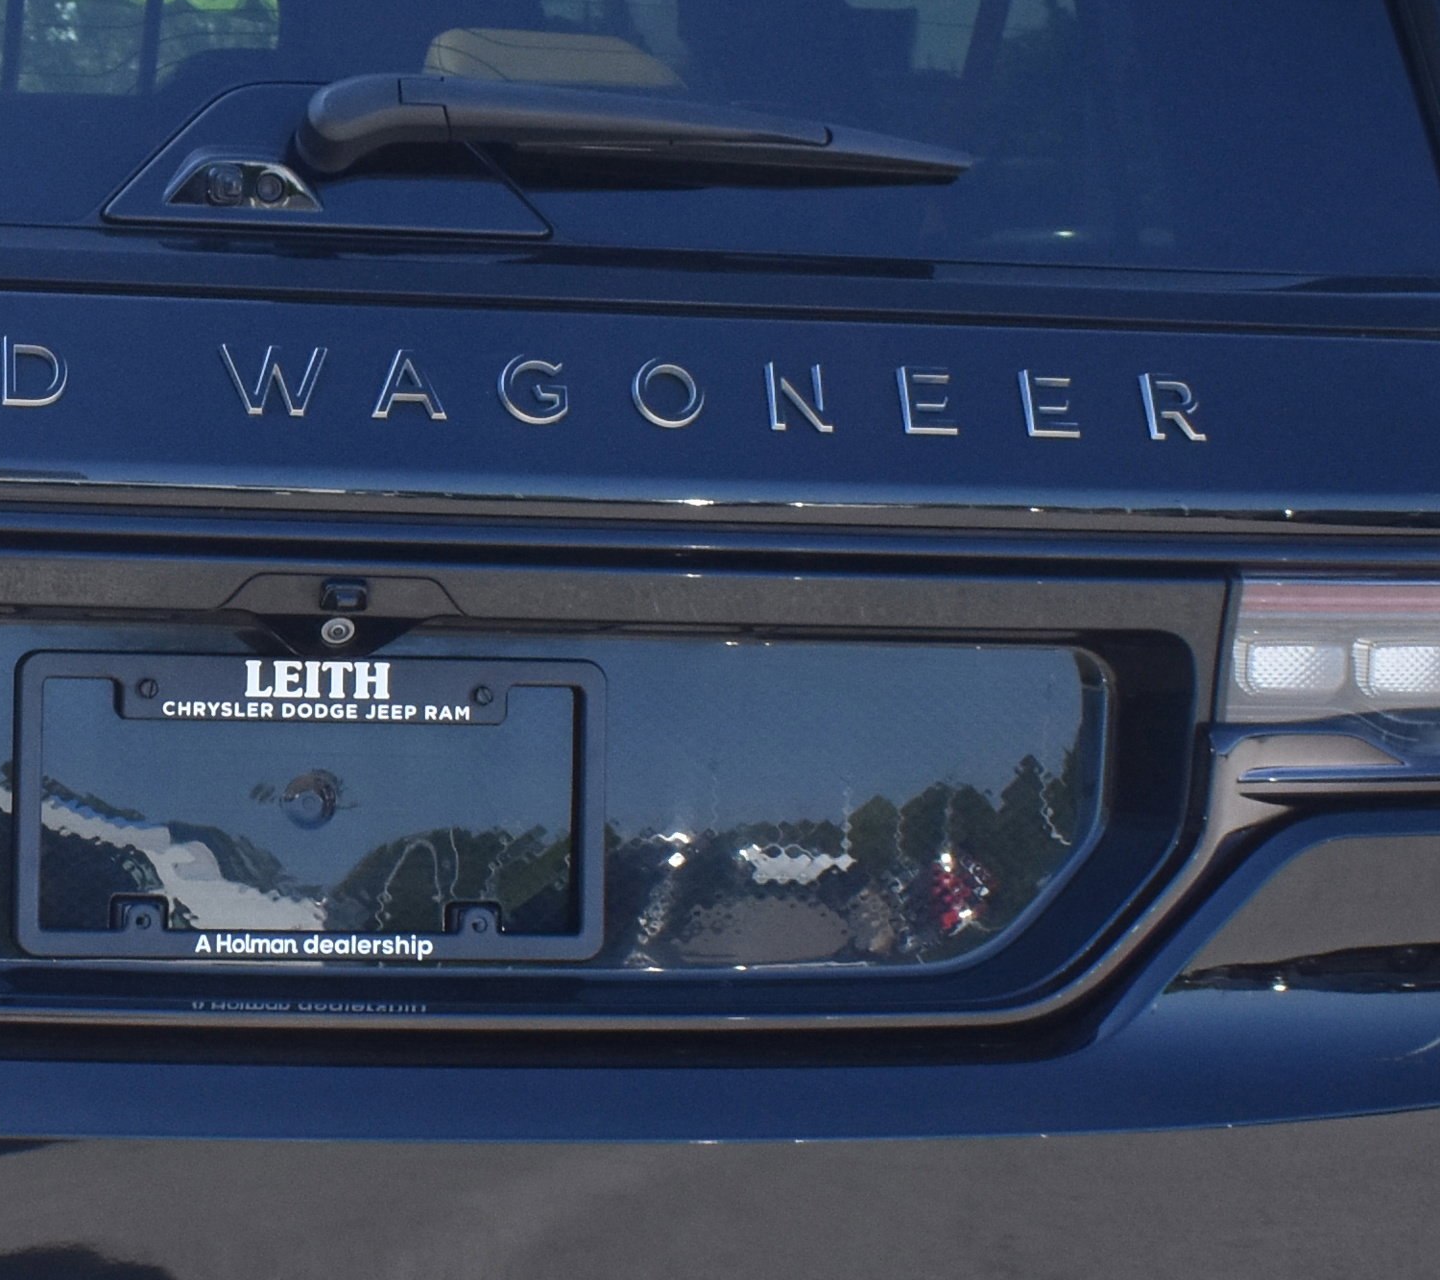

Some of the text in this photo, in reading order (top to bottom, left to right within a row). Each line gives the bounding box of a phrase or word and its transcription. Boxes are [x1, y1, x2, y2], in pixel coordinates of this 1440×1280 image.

[218, 342, 1208, 442] WAGONEER
[243, 659, 391, 700] LEITH
[161, 700, 471, 721] CHRYSLER DODGE JEEP RAM
[194, 933, 434, 962] A Holman dealership
